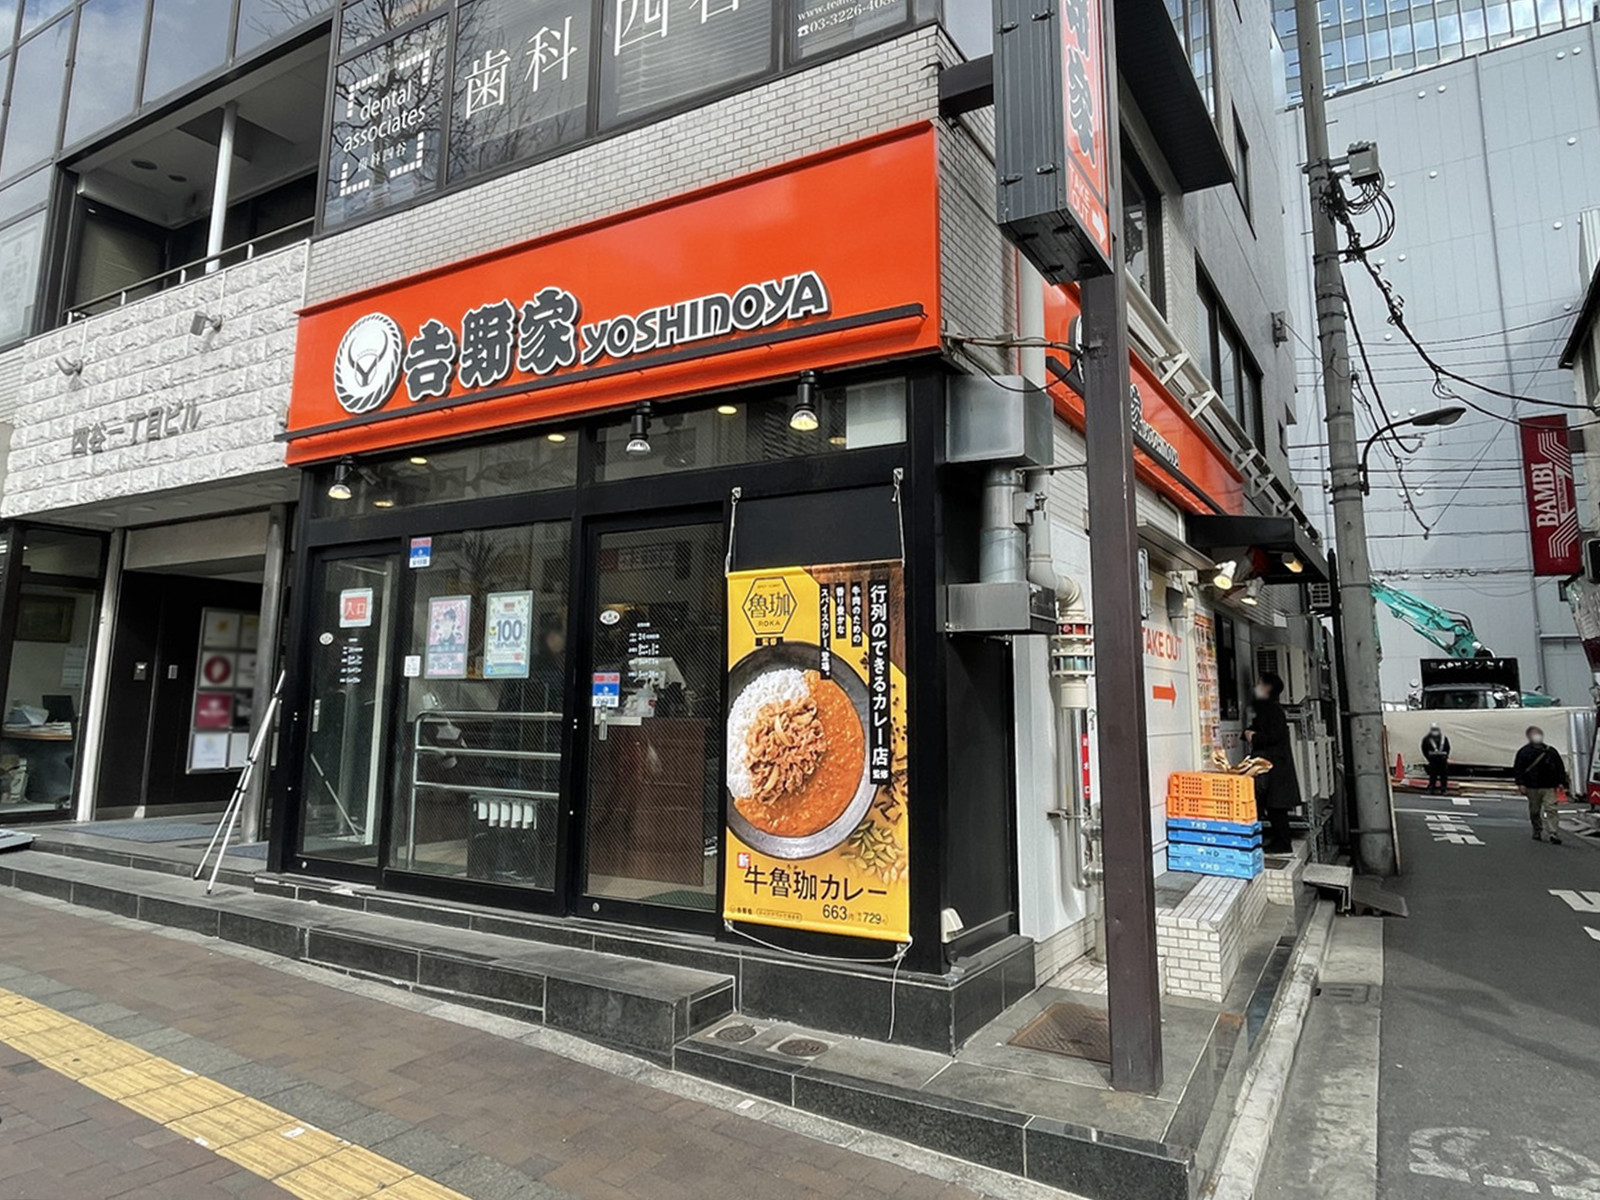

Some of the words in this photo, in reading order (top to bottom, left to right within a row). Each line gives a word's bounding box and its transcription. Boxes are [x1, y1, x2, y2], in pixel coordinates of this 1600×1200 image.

[464, 16, 577, 119] 歯科
[359, 79, 412, 121] dental
[343, 104, 426, 153] associates
[403, 286, 580, 402] 吉野家
[581, 270, 829, 365] YOSHINOYA
[1531, 461, 1559, 528] BAMBI
[345, 602, 367, 615] 入口
[748, 592, 791, 619] 魯珈
[758, 620, 781, 628] ROKA
[497, 619, 523, 642] 100
[1166, 634, 1182, 661] OUT
[870, 584, 889, 767] 行列のできるカレー店
[738, 852, 750, 868] 新
[743, 865, 888, 902] 牛魯珈カレー
